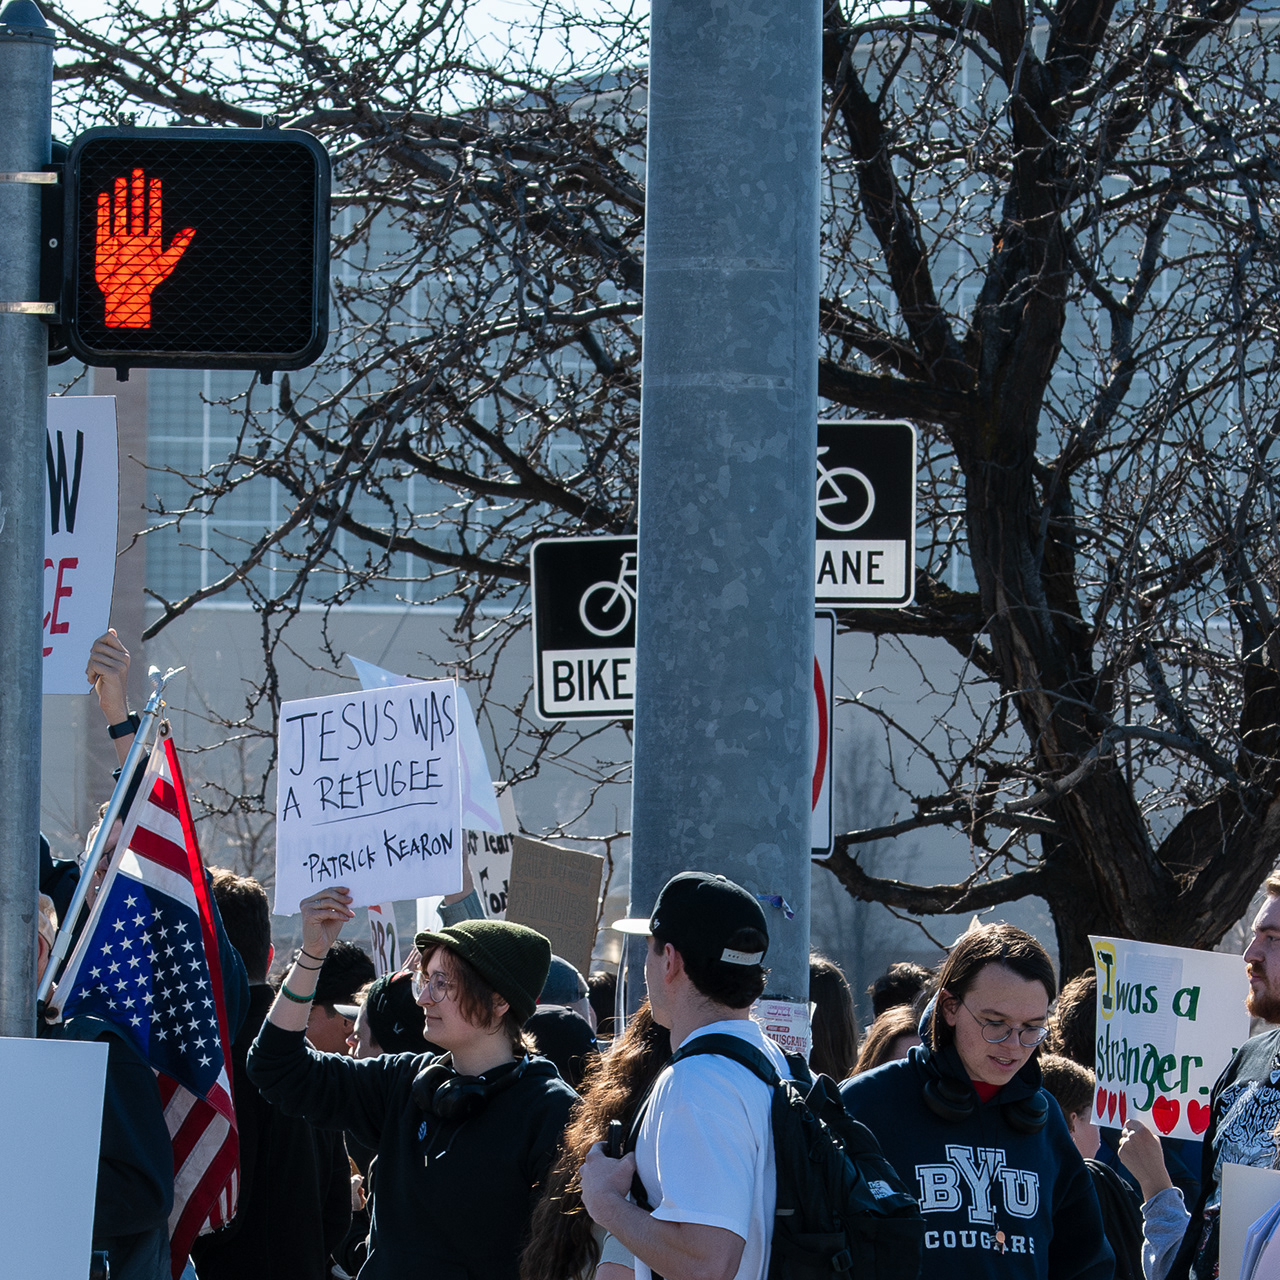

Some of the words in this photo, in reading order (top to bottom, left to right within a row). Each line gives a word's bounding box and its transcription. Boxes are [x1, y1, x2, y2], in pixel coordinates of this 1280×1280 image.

[818, 550, 885, 586] ANE
[552, 658, 634, 702] BIKE
[286, 700, 397, 776] JESUS
[410, 691, 455, 752] WAS
[282, 786, 302, 822] A
[313, 757, 444, 811] REFUGEE
[384, 829, 453, 867] KEARON
[1097, 950, 1114, 1010] I
[1117, 979, 1158, 1014] was
[1172, 986, 1201, 1021] a
[1097, 1024, 1210, 1111] stranger.
[915, 1144, 1040, 1225] BYU
